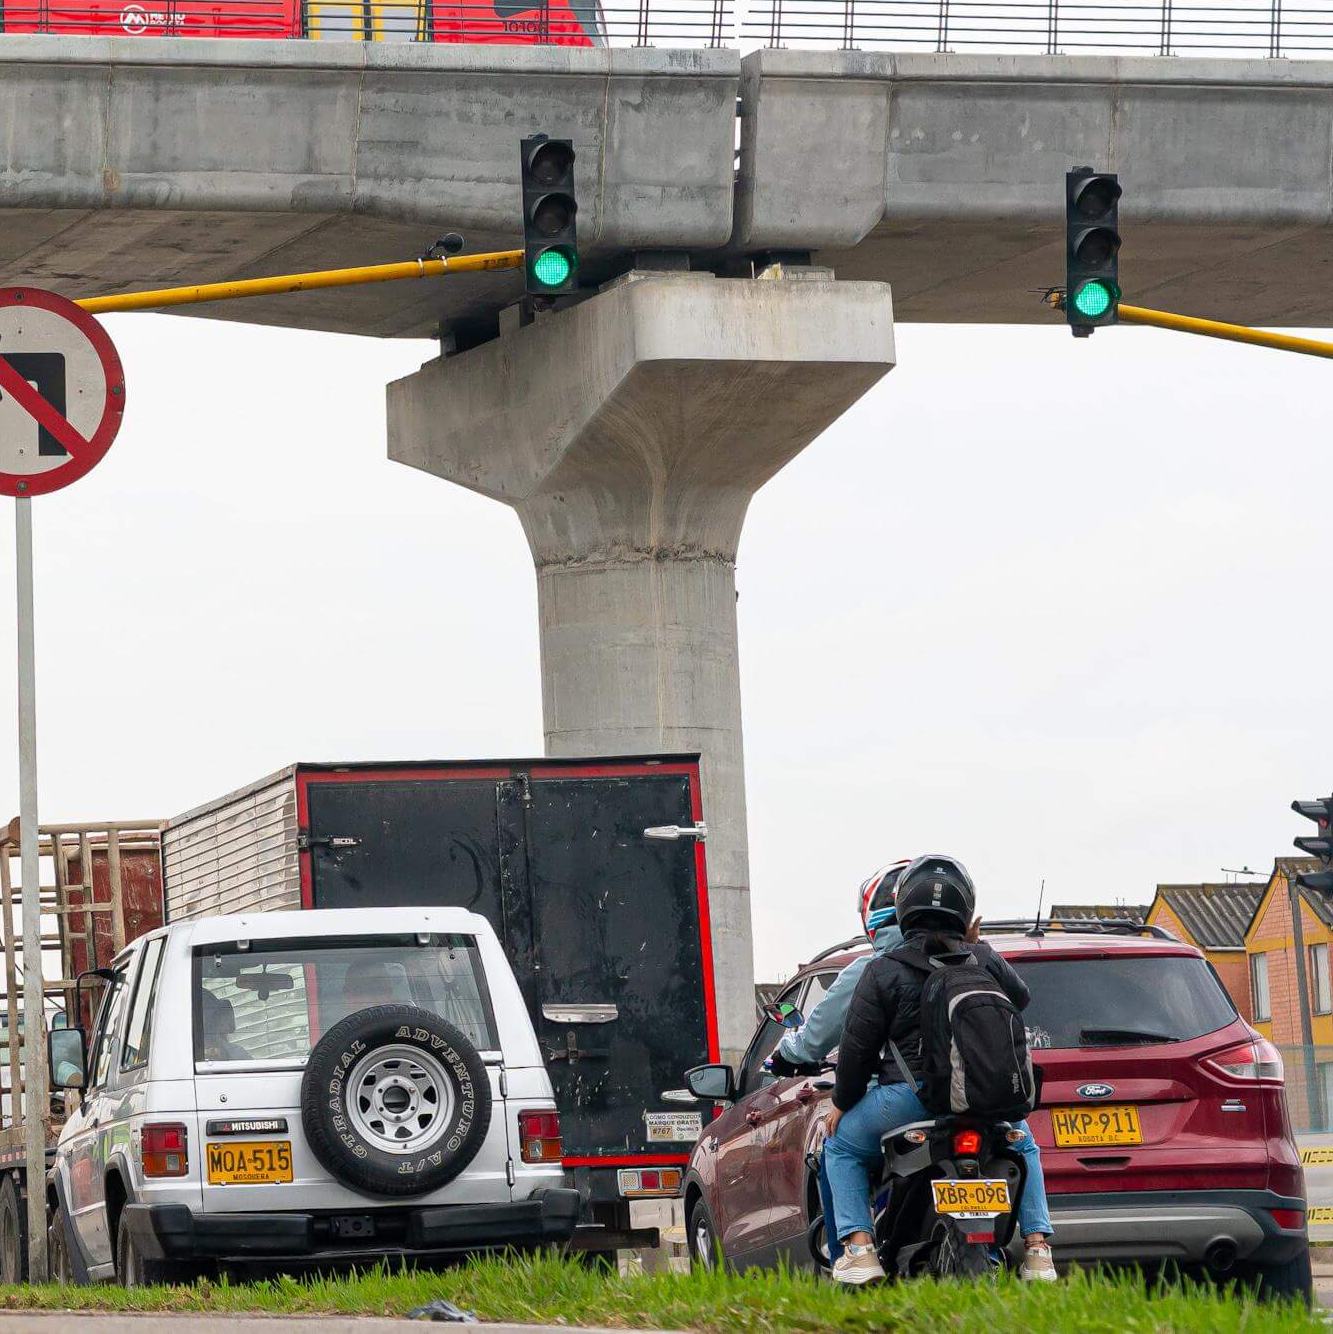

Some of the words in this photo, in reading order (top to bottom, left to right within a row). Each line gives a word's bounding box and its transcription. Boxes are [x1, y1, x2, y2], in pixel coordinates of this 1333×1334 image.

[329, 1040, 367, 1132] RADIAL
[395, 1026, 475, 1152] ADVENTURO
[1085, 1085, 1107, 1096] Ford
[231, 1120, 279, 1131] MITSUBISHI
[340, 1133, 368, 1159] GT
[398, 1151, 442, 1174] A/T
